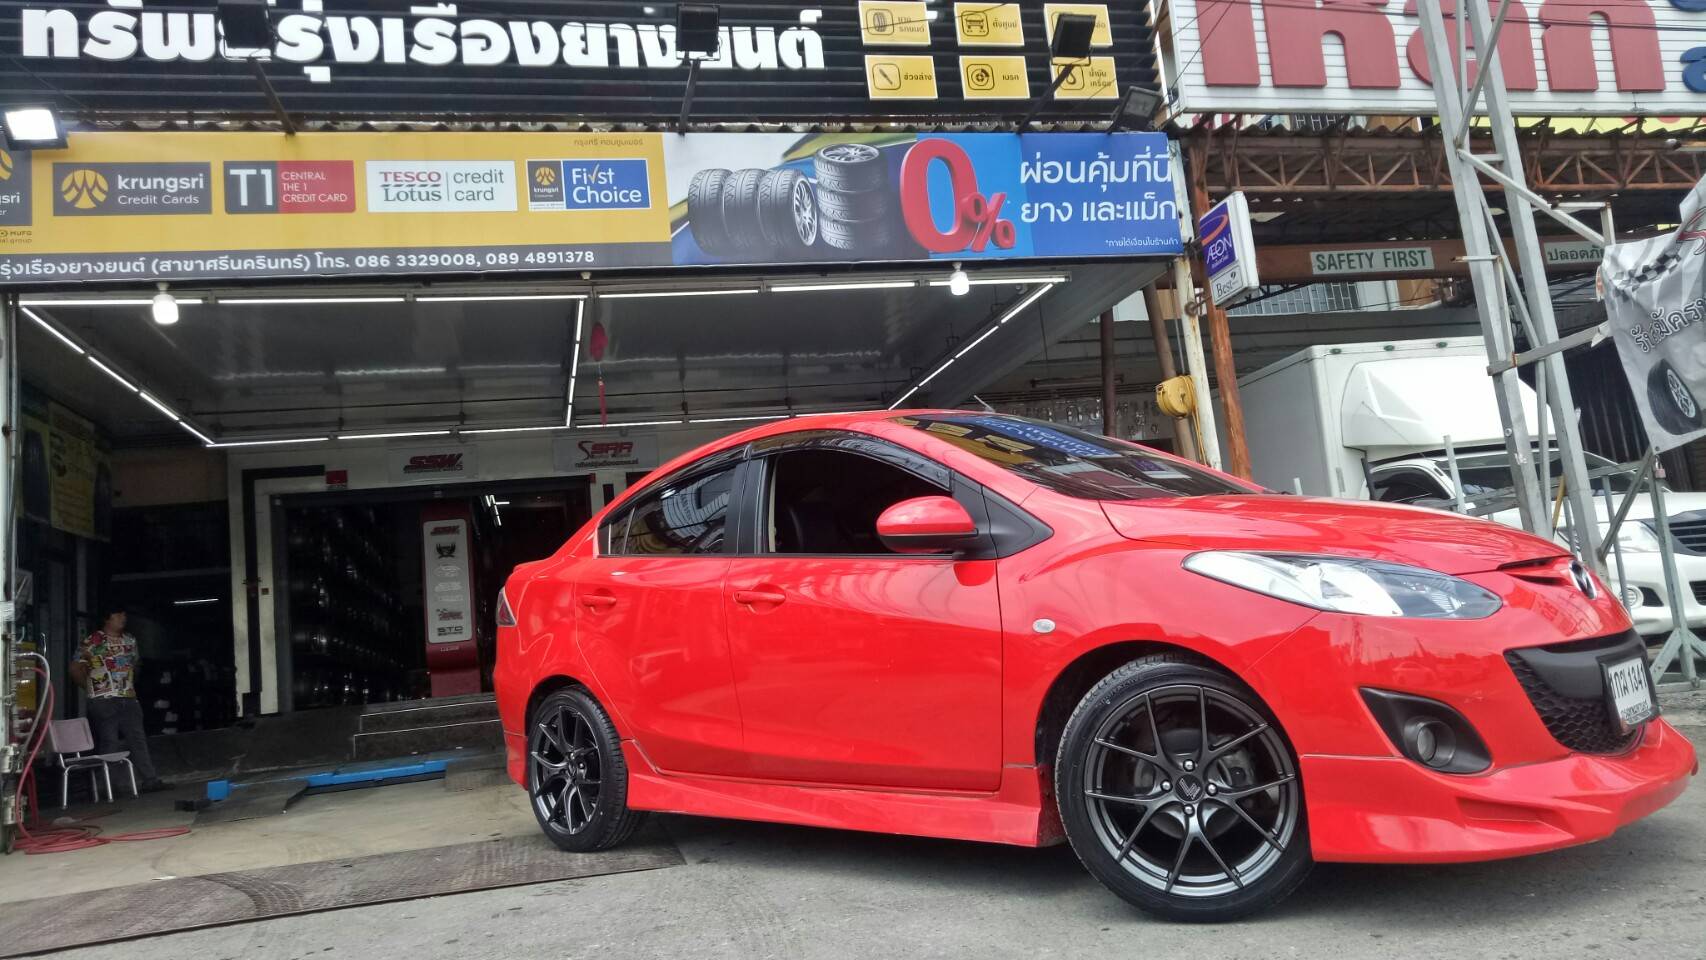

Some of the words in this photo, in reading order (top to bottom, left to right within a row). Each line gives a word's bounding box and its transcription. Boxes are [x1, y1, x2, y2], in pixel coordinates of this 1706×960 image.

[117, 173, 205, 193] krungsri
[281, 171, 327, 181] CENTRAL
[379, 171, 442, 183] TESCO
[453, 168, 505, 184] credit
[229, 168, 274, 206] T1
[282, 182, 301, 192] THE
[383, 187, 442, 202] Lotus
[454, 187, 494, 201] card
[573, 186, 642, 203] Choice
[118, 194, 158, 205] Credit
[161, 194, 200, 204] Cards
[283, 193, 316, 203] CREDIT
[318, 192, 348, 202] CARD
[900, 138, 1017, 253] 0%
[1021, 201, 1073, 223] ยาง
[1082, 191, 1177, 222] และแม็ก
[315, 251, 350, 268] โทร.
[354, 254, 391, 268] 086
[396, 252, 481, 267] 3329008,
[485, 251, 519, 264] 089
[524, 250, 595, 263] 4891378
[1316, 251, 1374, 270] SAFETY
[1383, 249, 1427, 267] FIRST
[1627, 663, 1647, 693] 1341
